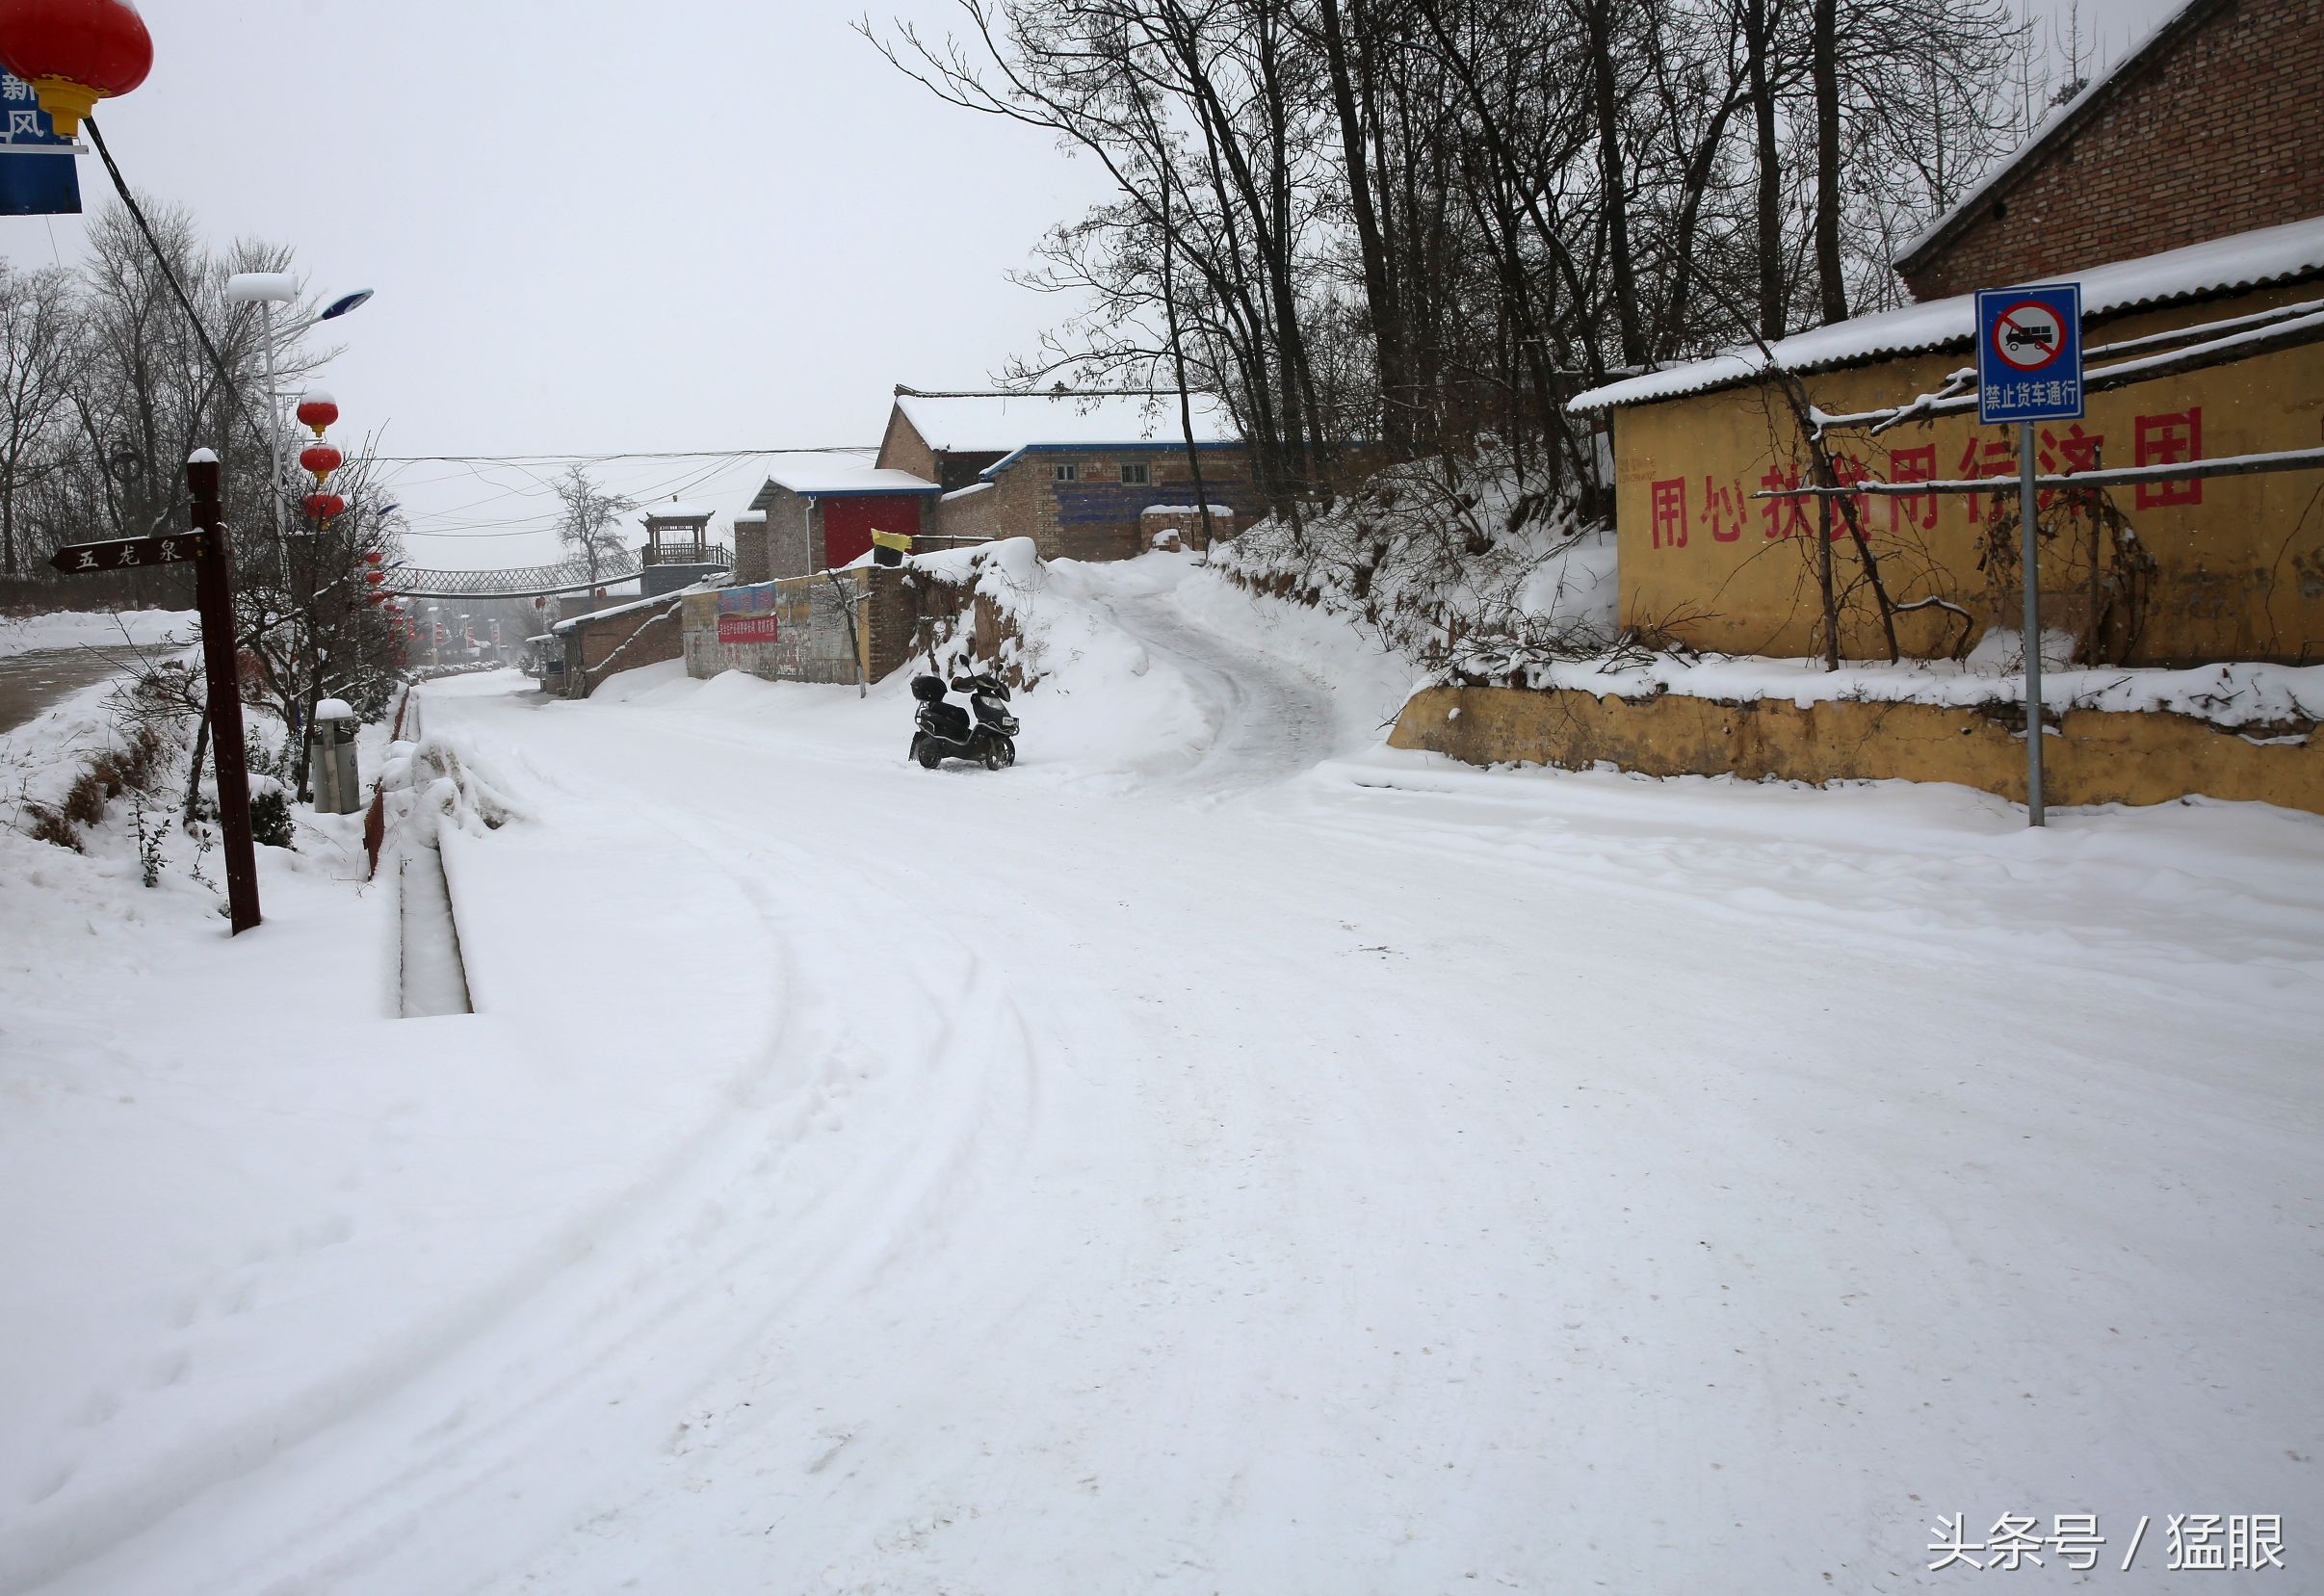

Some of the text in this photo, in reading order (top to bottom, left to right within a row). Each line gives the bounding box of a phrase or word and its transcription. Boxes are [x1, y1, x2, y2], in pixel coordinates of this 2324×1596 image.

[9, 110, 44, 137] 风
[1985, 379, 2076, 410] 禁止货车通行
[76, 539, 182, 570] 五龙泉
